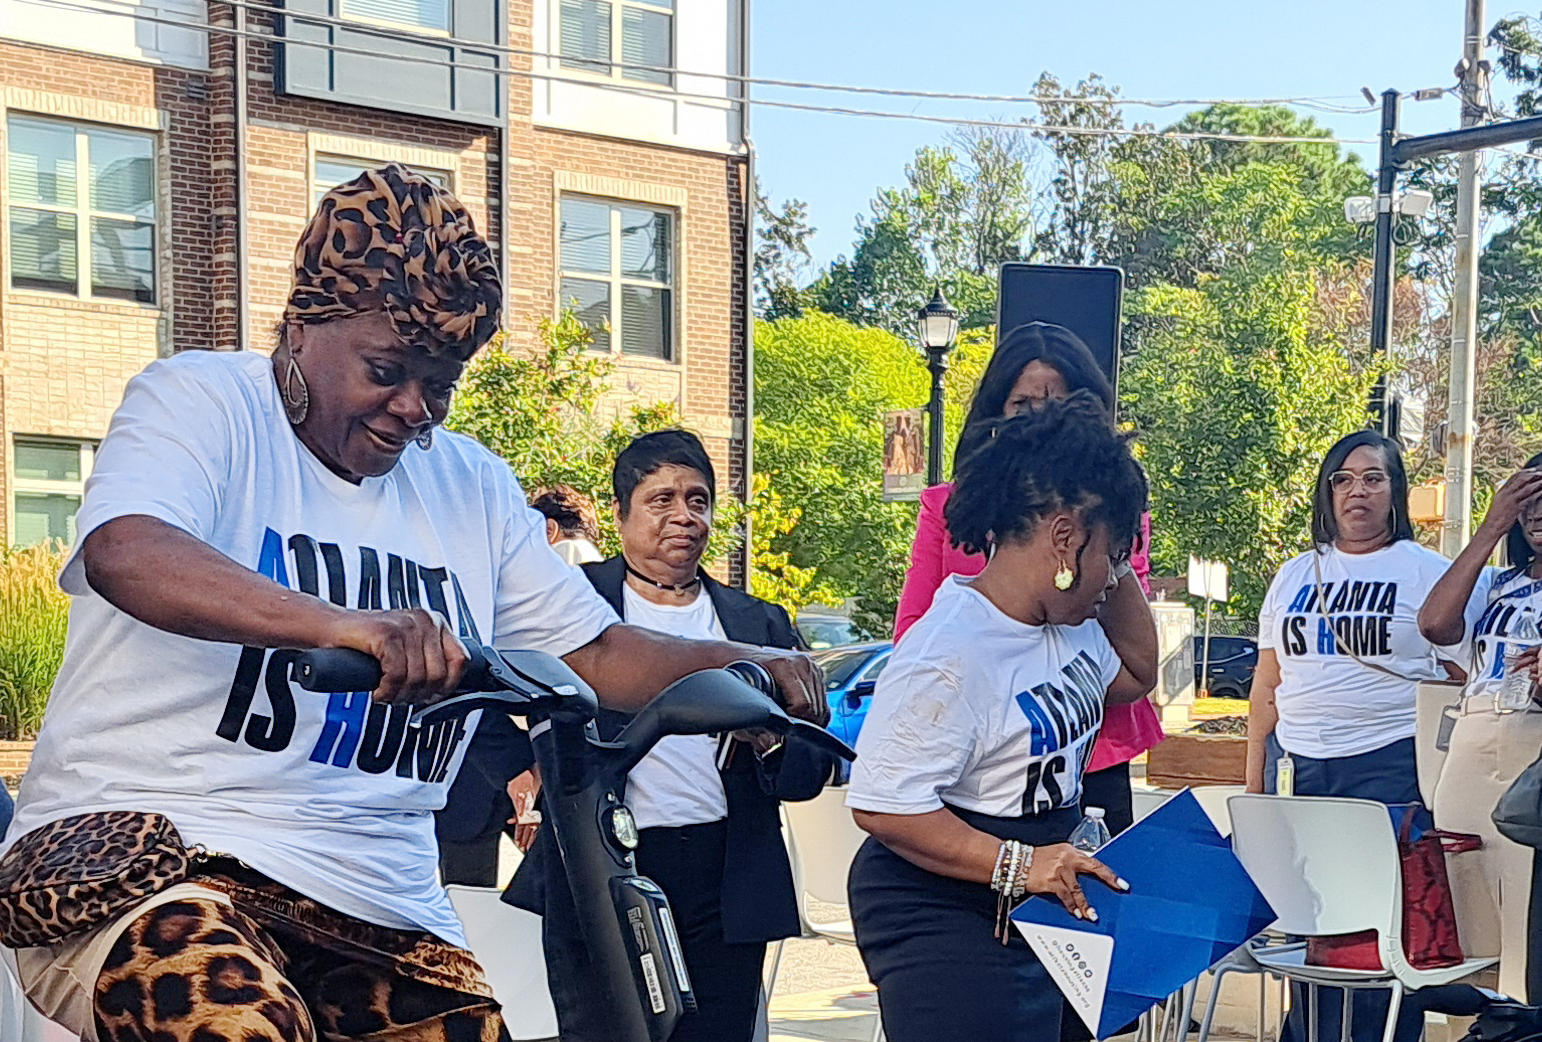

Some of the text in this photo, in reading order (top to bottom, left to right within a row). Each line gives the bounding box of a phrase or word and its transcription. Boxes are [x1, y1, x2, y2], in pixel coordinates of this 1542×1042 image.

[1281, 615, 1393, 657] IS HOME
[216, 644, 300, 752] IS
[1021, 755, 1066, 816] IS
